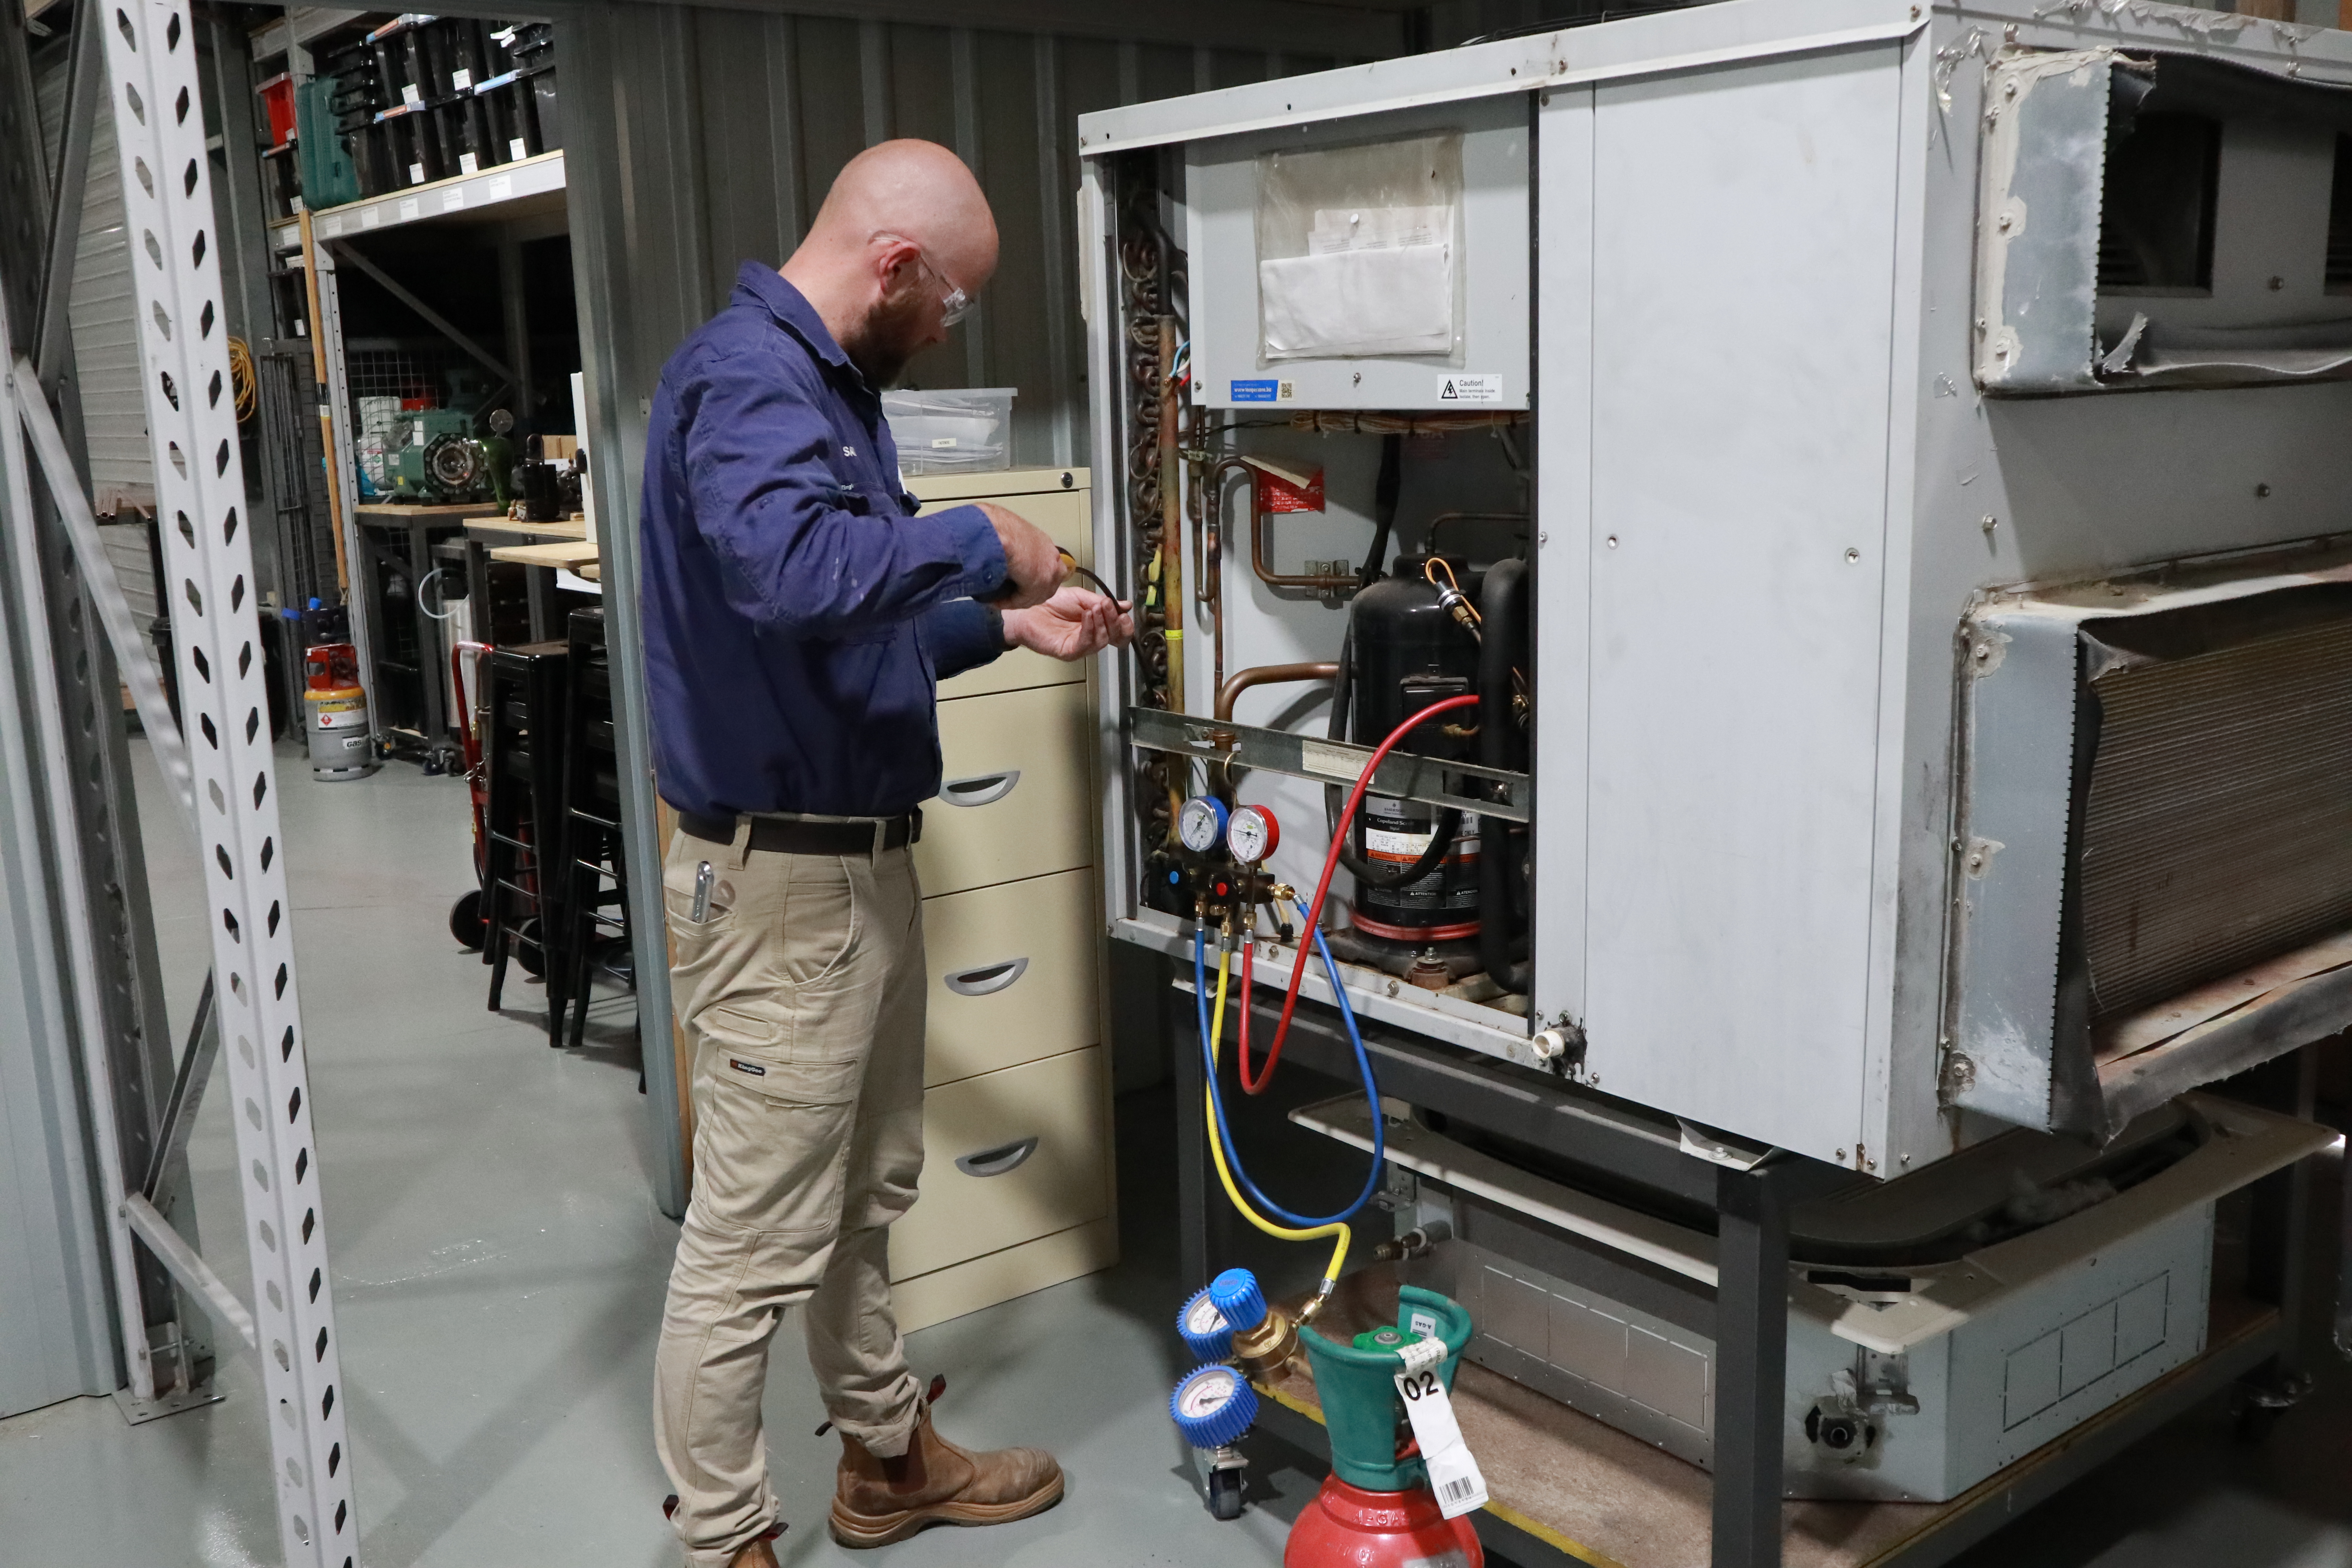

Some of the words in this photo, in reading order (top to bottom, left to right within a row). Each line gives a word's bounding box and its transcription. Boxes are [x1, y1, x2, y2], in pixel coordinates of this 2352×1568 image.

[738, 1063, 762, 1073] KingGee
[1415, 1321, 1432, 1329] A-GAS
[1403, 1371, 1439, 1401] 02
